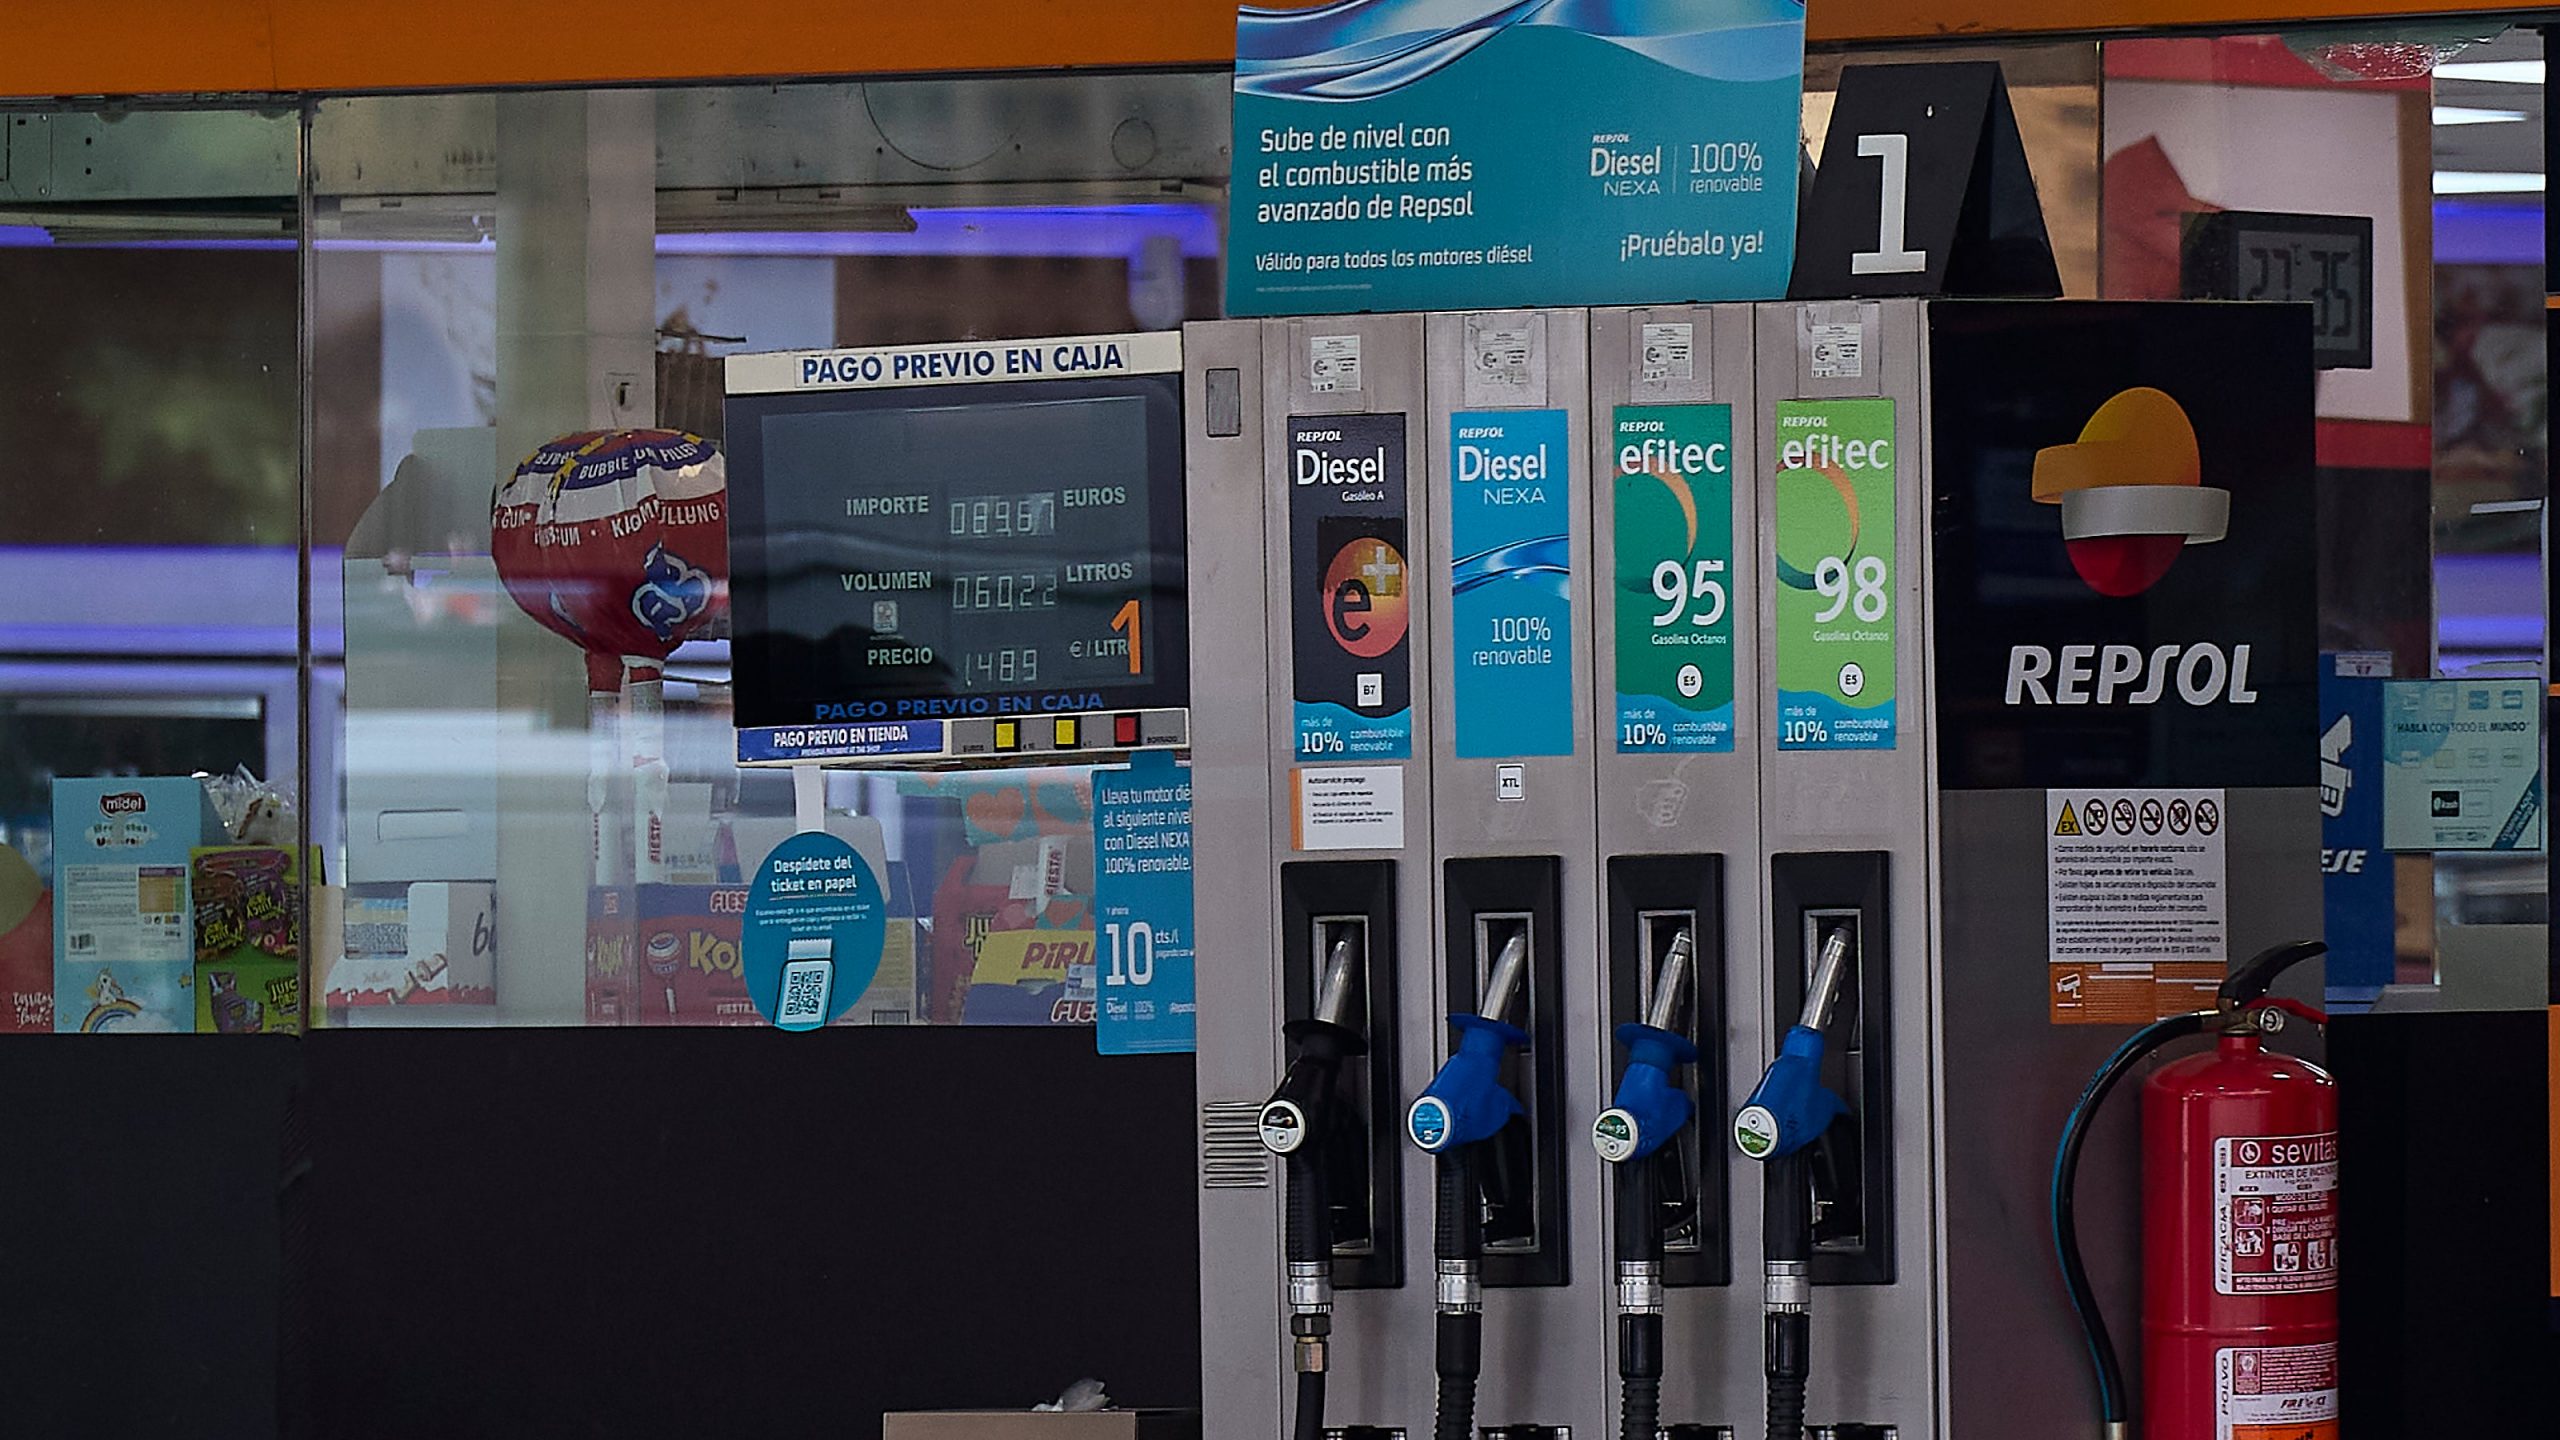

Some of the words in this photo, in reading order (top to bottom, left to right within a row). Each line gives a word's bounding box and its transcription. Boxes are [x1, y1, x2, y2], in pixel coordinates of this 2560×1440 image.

[1261, 126, 1314, 152] Sube
[1320, 125, 1346, 150] de
[1353, 123, 1405, 149] nivel
[1411, 127, 1449, 147] con
[1592, 133, 1630, 143] REPSOL
[1590, 146, 1661, 177] Diesel
[1690, 141, 1763, 174] 100%
[1259, 162, 1279, 187] el
[1286, 158, 1420, 185] combustible
[1427, 154, 1472, 182] más
[1604, 180, 1661, 196] NEXA
[1690, 176, 1763, 194] renovable
[1258, 195, 1360, 223] avanzado
[1367, 194, 1393, 218] de
[1400, 191, 1474, 223] Repsol
[1851, 134, 1927, 275] 1
[1621, 230, 1724, 262] ¡Pruébalo
[1730, 231, 1764, 260] ya!
[1256, 252, 1302, 272] Válido
[1306, 254, 1340, 274] para
[1344, 250, 1387, 269] todos
[1392, 250, 1415, 267] los
[1419, 248, 1482, 267] motores
[1487, 245, 1533, 264] diésel
[802, 356, 882, 384] PAGO
[893, 350, 995, 380] PREVIO
[1006, 348, 1043, 374] EN
[1053, 343, 1124, 372] CAJA
[1459, 427, 1504, 439] REPSOL
[1619, 421, 1665, 433] REPSOL
[1783, 416, 1828, 428] REPSOL
[1297, 430, 1342, 442] REPSOL
[1458, 443, 1546, 482] Diesel
[1619, 438, 1726, 475] efitec
[1782, 433, 1889, 470] efitec
[578, 456, 630, 480] BUBBLE
[1297, 447, 1384, 485] Diesel
[846, 495, 929, 517] IMPORTE
[1063, 486, 1126, 507] EUROS
[1342, 490, 1376, 502] Gasóleo
[1377, 490, 1384, 501] A
[1484, 488, 1546, 505] NEXA
[841, 571, 932, 592] VOLUMEN
[1066, 562, 1133, 583] LITROS
[1652, 559, 1726, 627] 95
[1814, 556, 1888, 623] 98
[1111, 600, 1141, 674] 1
[1491, 617, 1551, 642] 100%
[1651, 633, 1688, 646] Gasolina
[1691, 633, 1727, 645] Octanos
[1813, 630, 1850, 643] Gasolina
[1852, 630, 1889, 642] Octanos
[867, 647, 933, 665] PRECIO
[1070, 641, 1083, 658] €
[1095, 638, 1129, 656] LITR
[1472, 645, 1552, 666] renovable
[1683, 676, 1696, 687] E5
[1845, 674, 1857, 685] E5
[2004, 642, 2258, 705] REPSOL
[1363, 685, 1375, 695] B7
[815, 701, 887, 720] PAGO
[898, 698, 988, 715] PREVIO
[1000, 696, 1032, 712] EN
[1041, 692, 1104, 711] CAJA
[1644, 708, 1656, 720] de
[1805, 705, 1817, 716] de
[773, 732, 805, 747] PAGO
[808, 729, 847, 746] PREVIO
[850, 728, 865, 743] EN
[868, 726, 908, 742] TIENDA
[1302, 731, 1344, 753] 10%
[1350, 728, 1404, 739] combustible
[1623, 723, 1666, 745] 10%
[1673, 722, 1727, 733] combustible
[1672, 734, 1717, 745] renovable
[1784, 720, 1827, 743] 10%
[1834, 718, 1889, 729] combustible
[1834, 731, 1879, 742] renovable
[1350, 741, 1394, 752] renovable
[1102, 787, 1129, 805] Lleva
[1130, 788, 1142, 803] tu
[1143, 787, 1174, 803] motor
[1175, 783, 1192, 801] dié
[1502, 778, 1520, 789] XTL
[1103, 810, 1114, 828] al
[1116, 809, 1166, 831] siguiente
[1104, 837, 1124, 851] con
[1126, 832, 1159, 850] Diesel
[1161, 831, 1190, 848] NEXA
[774, 857, 831, 875] Despídete
[834, 855, 852, 870] del
[1105, 857, 1136, 874] 100%
[1138, 853, 1191, 873] renovable.
[771, 878, 805, 893] ticket
[807, 879, 822, 891] en
[825, 874, 857, 893] papel
[710, 890, 749, 912] FIES
[1105, 921, 1153, 986] 10
[2296, 1168, 2308, 1178] DE
[2221, 1357, 2229, 1416] POLVO
